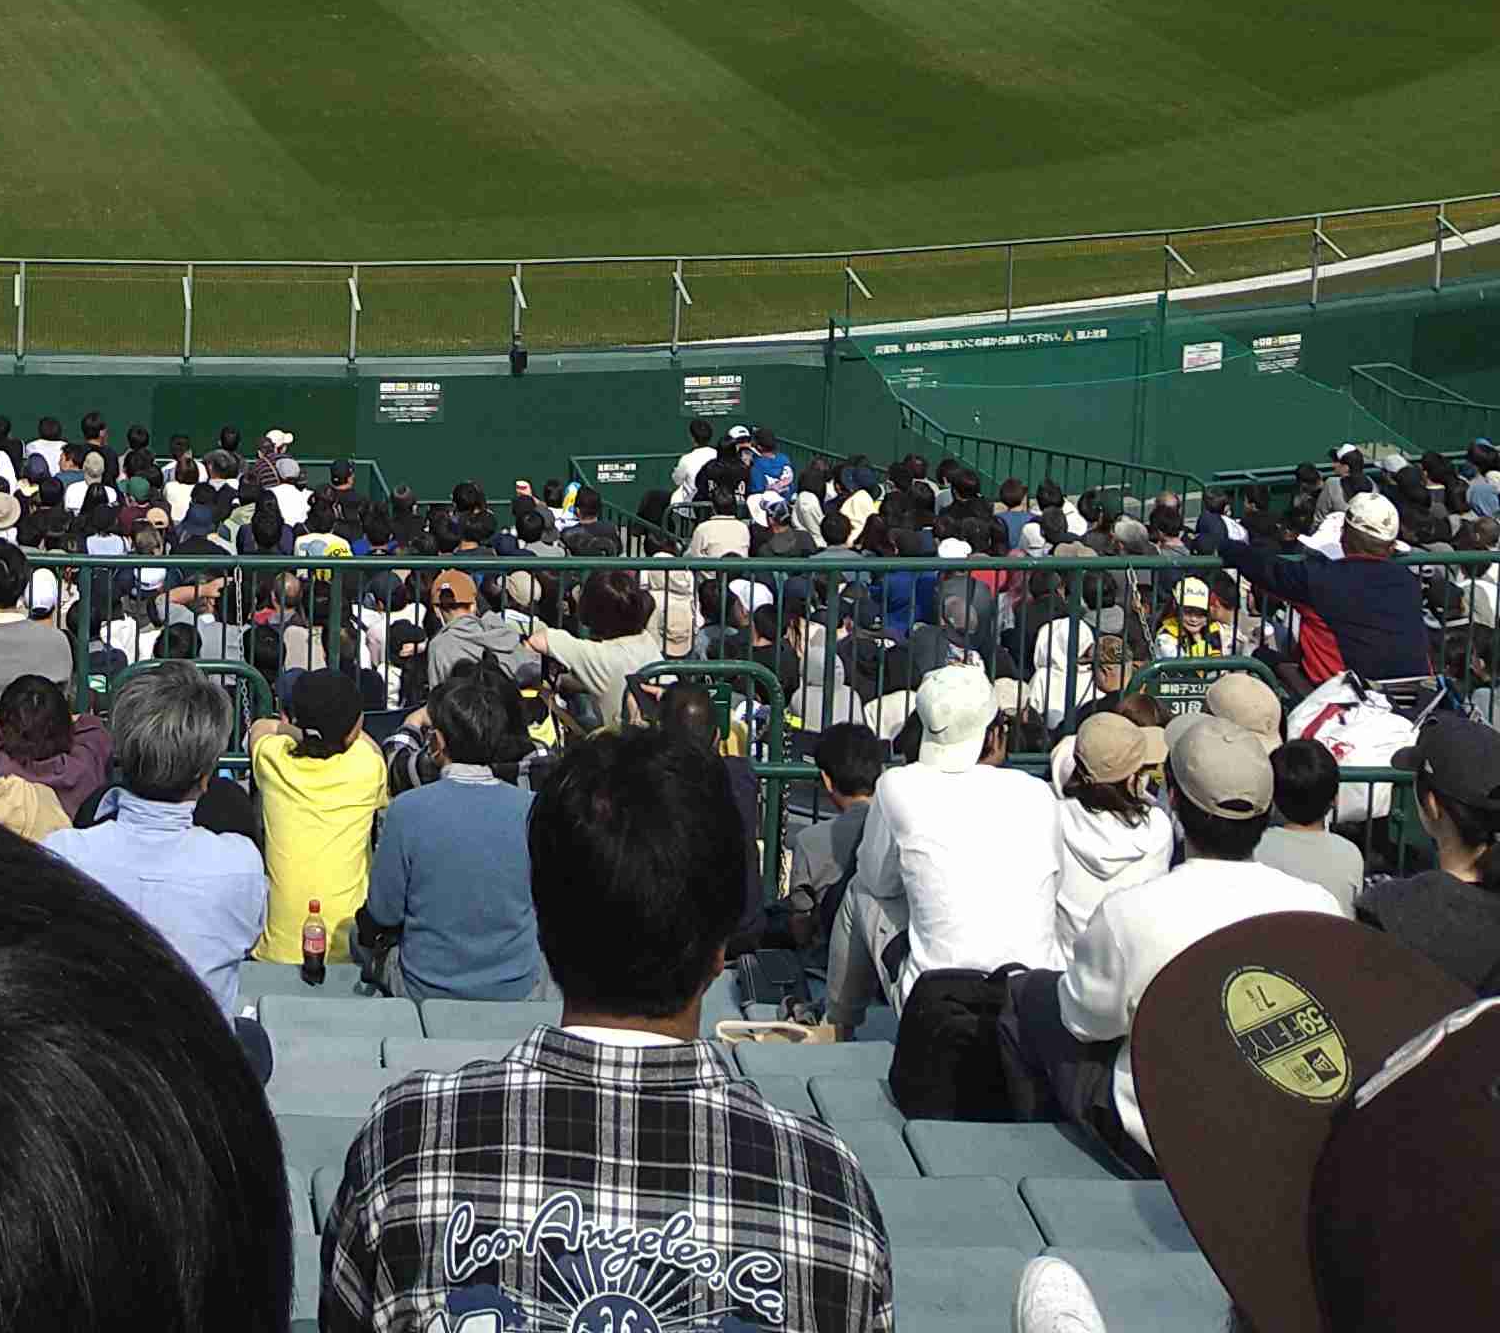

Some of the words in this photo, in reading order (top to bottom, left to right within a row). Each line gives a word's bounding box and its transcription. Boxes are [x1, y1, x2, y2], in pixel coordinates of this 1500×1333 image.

[1160, 683, 1208, 694] 車椅子エリ
[1171, 700, 1203, 715] 31段
[444, 1201, 522, 1283] Los
